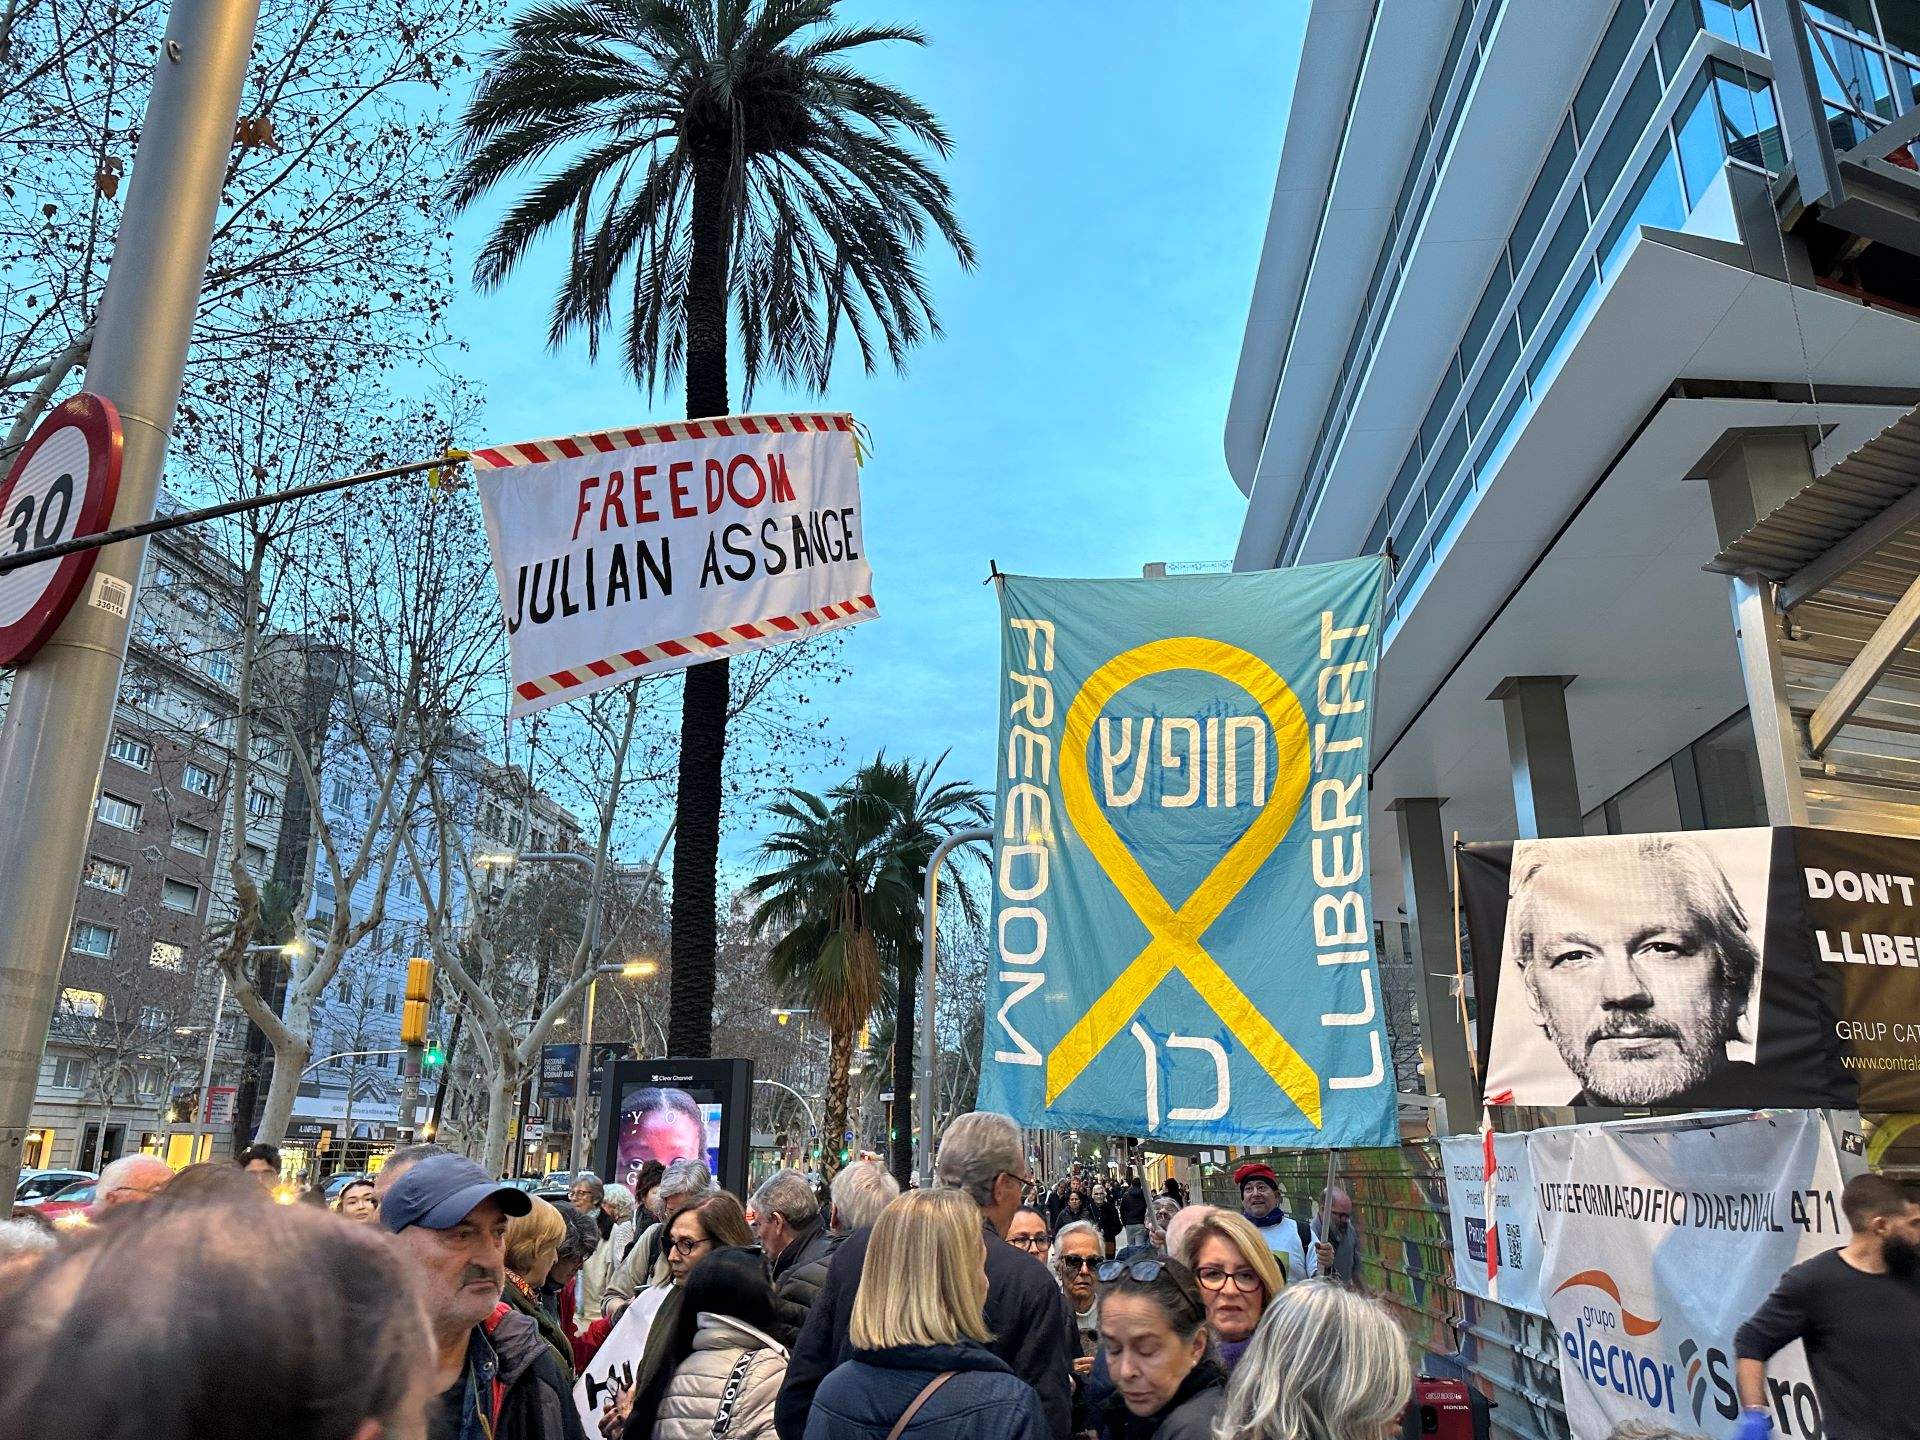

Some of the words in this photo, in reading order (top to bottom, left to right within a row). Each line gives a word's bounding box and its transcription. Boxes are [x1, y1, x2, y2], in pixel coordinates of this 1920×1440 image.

[0, 473, 73, 576] 30
[572, 453, 796, 540] FREEDOM
[96, 599, 123, 615] 330114
[507, 536, 673, 635] JULIAN
[699, 507, 858, 589] ASSANGE
[1098, 715, 1266, 808] חופש
[994, 617, 1055, 1067] FREEDOM
[1311, 611, 1383, 1090] LLIBERTAT
[1804, 867, 1915, 907] DON'T
[1815, 930, 1920, 968] LLIBE
[1835, 1020, 1887, 1042] GRUP
[1694, 1191, 1785, 1233] DIAGONAL
[1790, 1189, 1840, 1235] 471
[1583, 1305, 1616, 1329] grupo
[1563, 1317, 1676, 1414] elecnor
